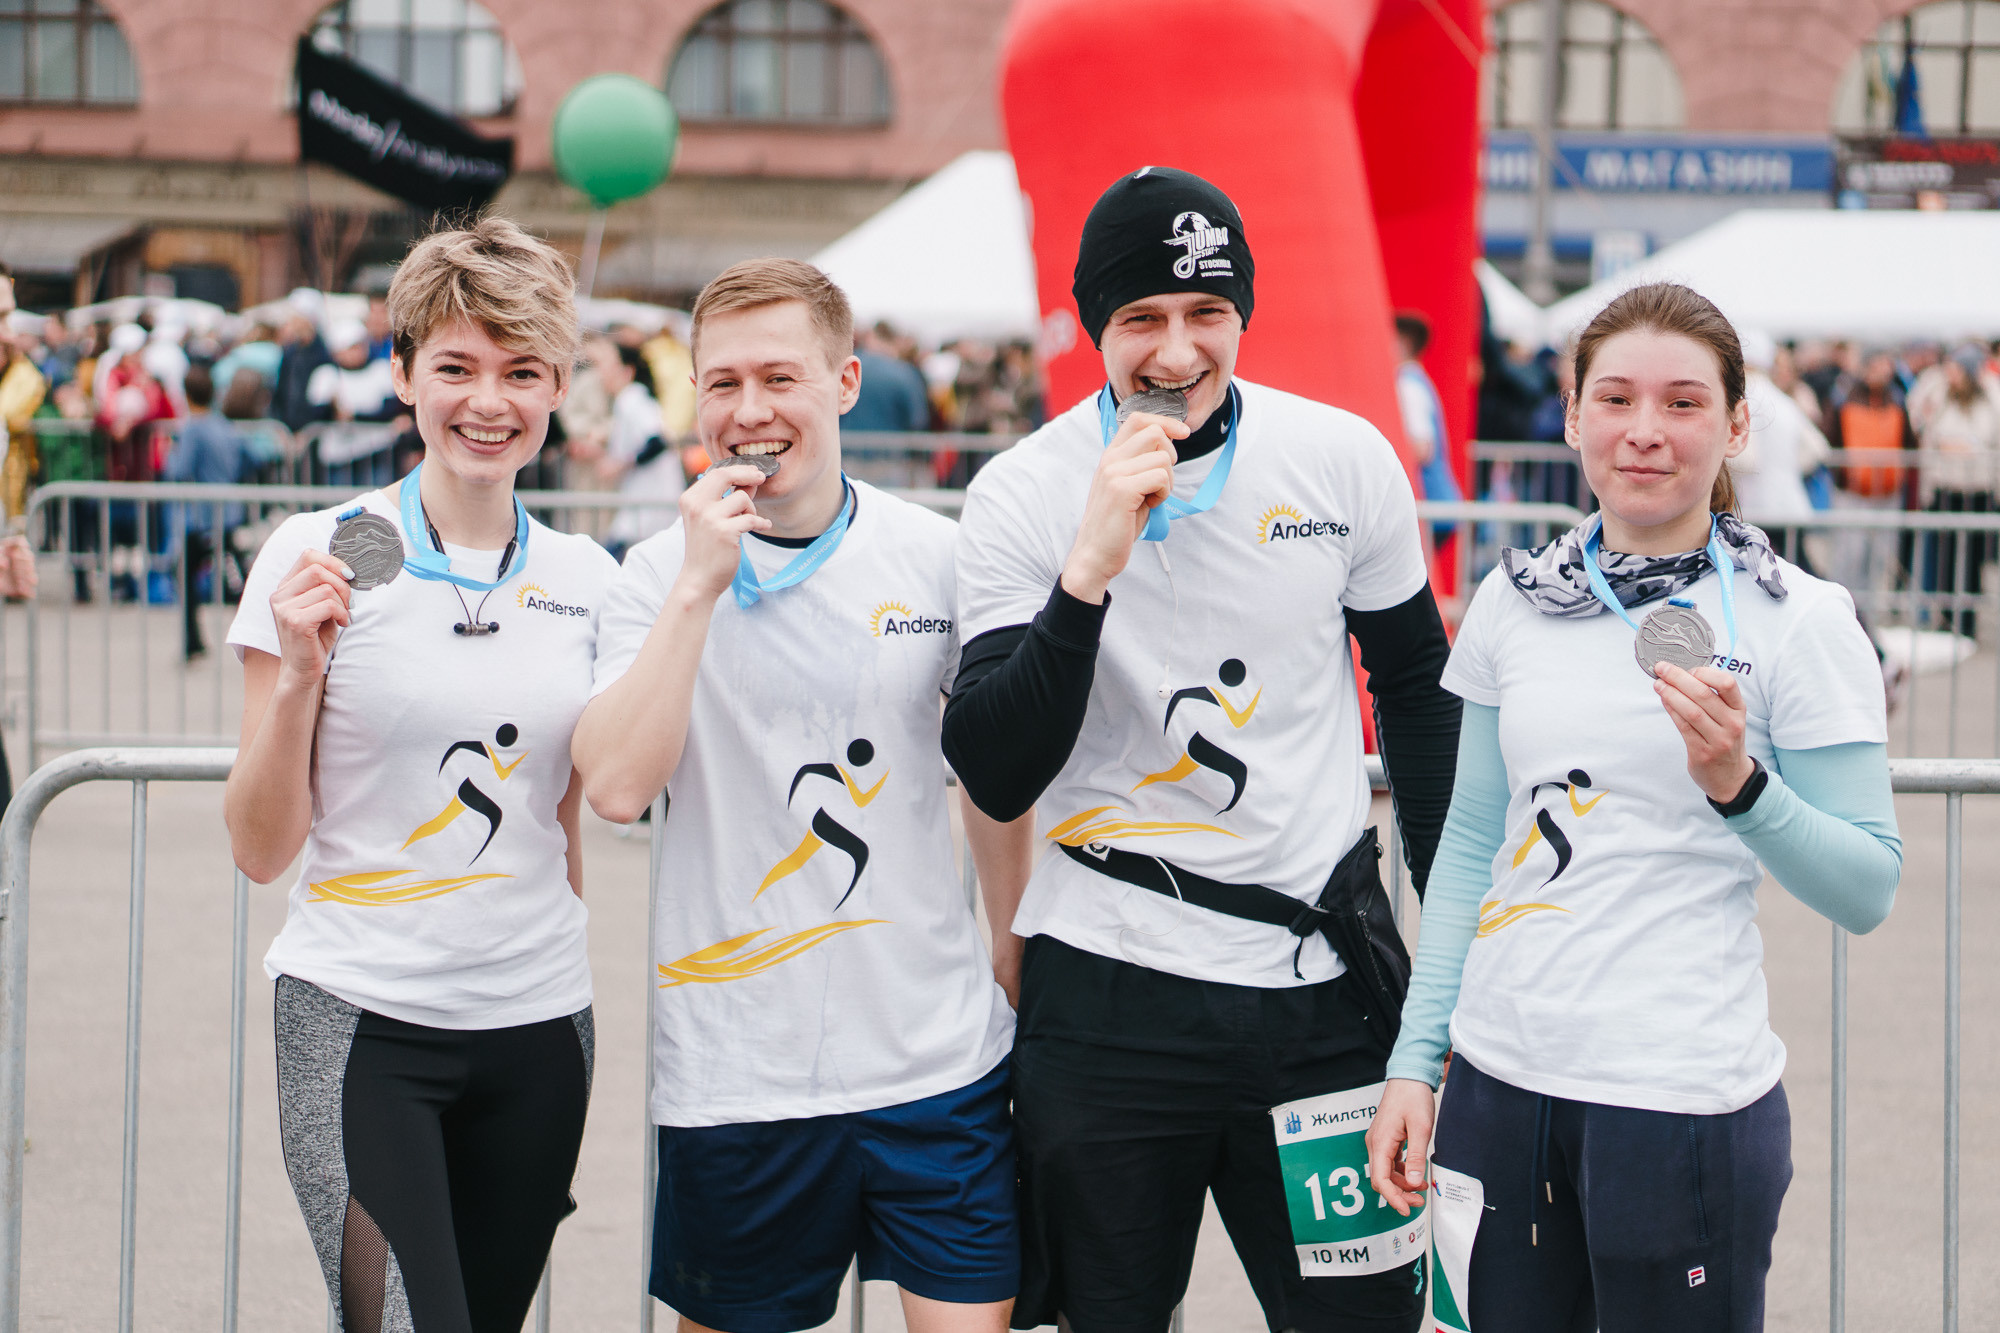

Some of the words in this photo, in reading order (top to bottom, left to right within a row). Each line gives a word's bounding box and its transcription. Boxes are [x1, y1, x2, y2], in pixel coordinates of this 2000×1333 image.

[1584, 150, 1792, 189] МАГАЗИН
[1270, 518, 1350, 541] Anderse
[798, 541, 832, 573] MARATHON
[1710, 654, 1752, 675] rsen
[1311, 1105, 1378, 1127] Жилстр
[1312, 1249, 1333, 1263] 10
